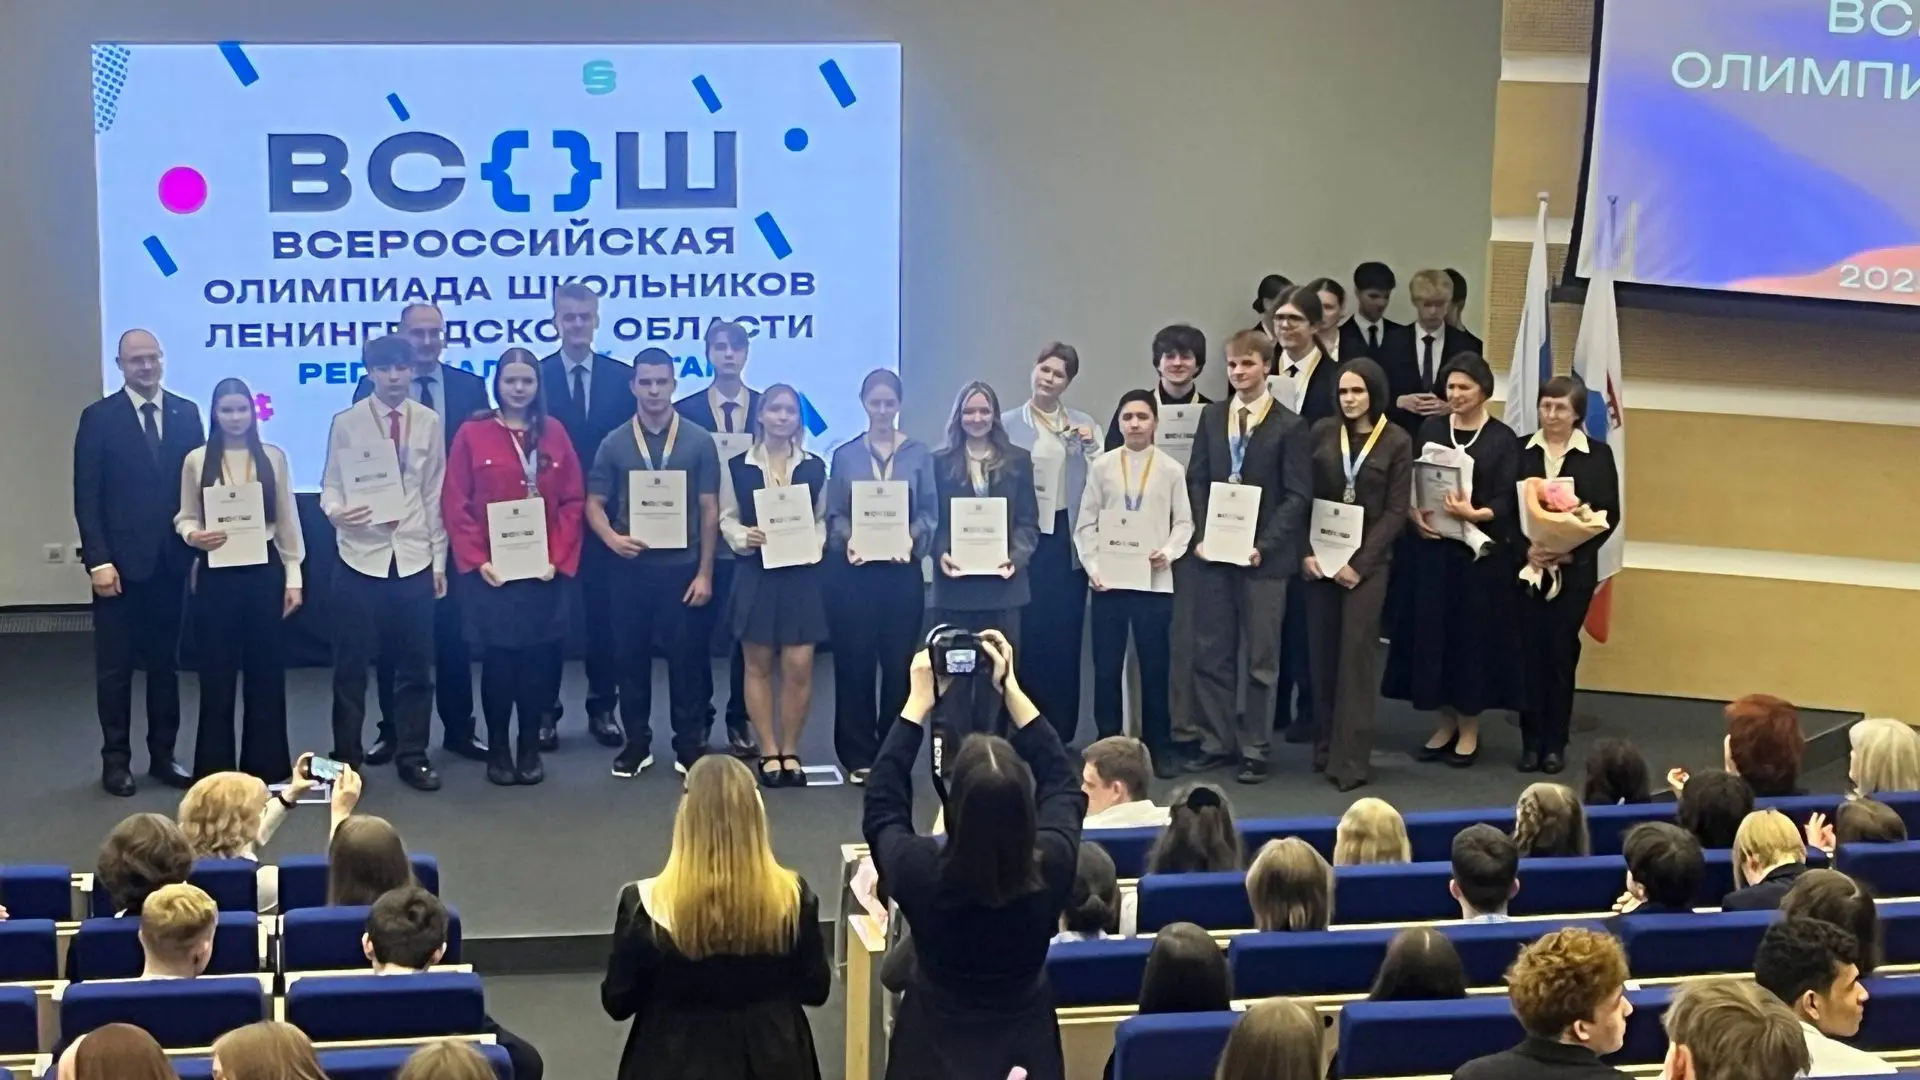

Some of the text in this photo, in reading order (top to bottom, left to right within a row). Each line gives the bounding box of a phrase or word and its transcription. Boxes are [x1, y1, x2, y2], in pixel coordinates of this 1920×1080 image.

[1829, 0, 1920, 37] ВС
[272, 218, 735, 260] ВСЕРОССИЙСКАЯ
[203, 276, 493, 307] ОЛИМПИАДА
[1839, 264, 1920, 293] 202
[613, 314, 814, 347] ОБЛСТИ
